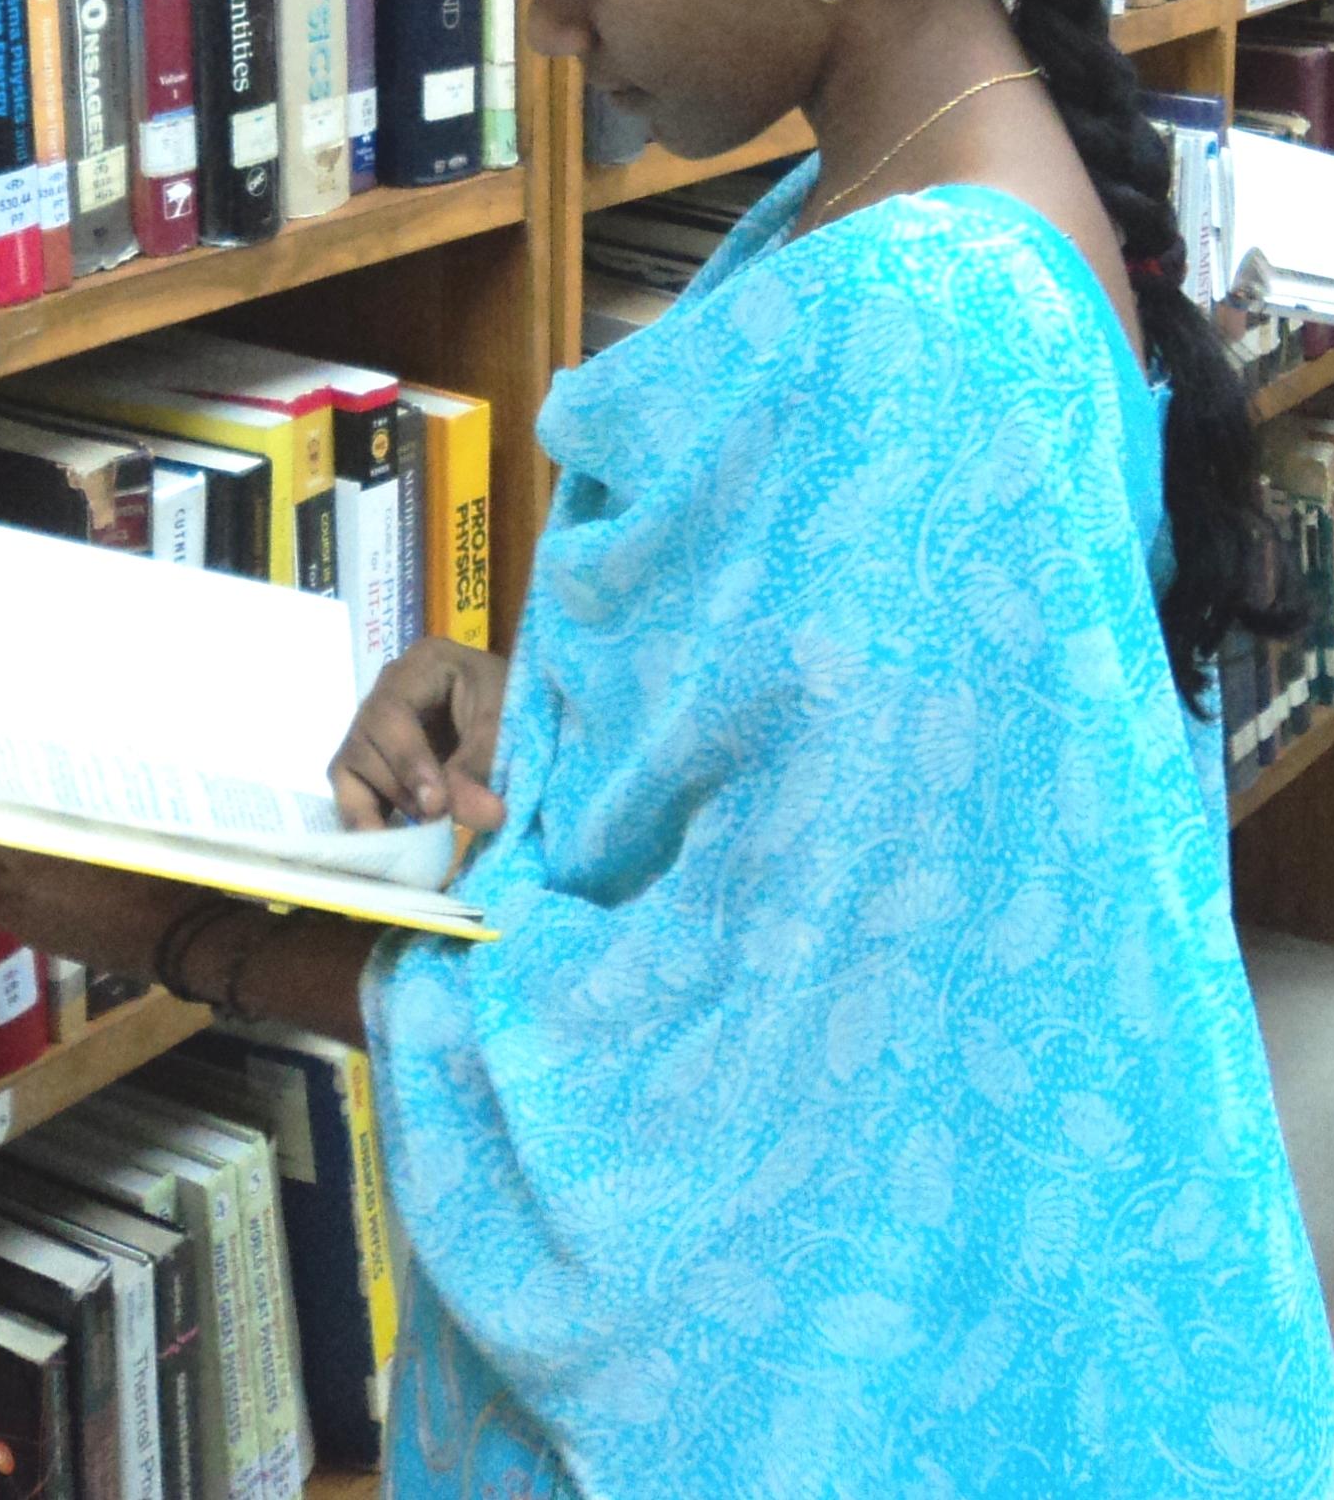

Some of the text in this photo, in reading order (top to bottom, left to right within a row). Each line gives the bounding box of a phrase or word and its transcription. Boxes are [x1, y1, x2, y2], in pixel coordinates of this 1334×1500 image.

[9, 47, 27, 121] Physics
[454, 504, 470, 614] PHYSICS
[470, 497, 487, 612] PROJECT
[366, 579, 381, 655] IIT-JEE
[131, 1346, 155, 1453] Thermal
